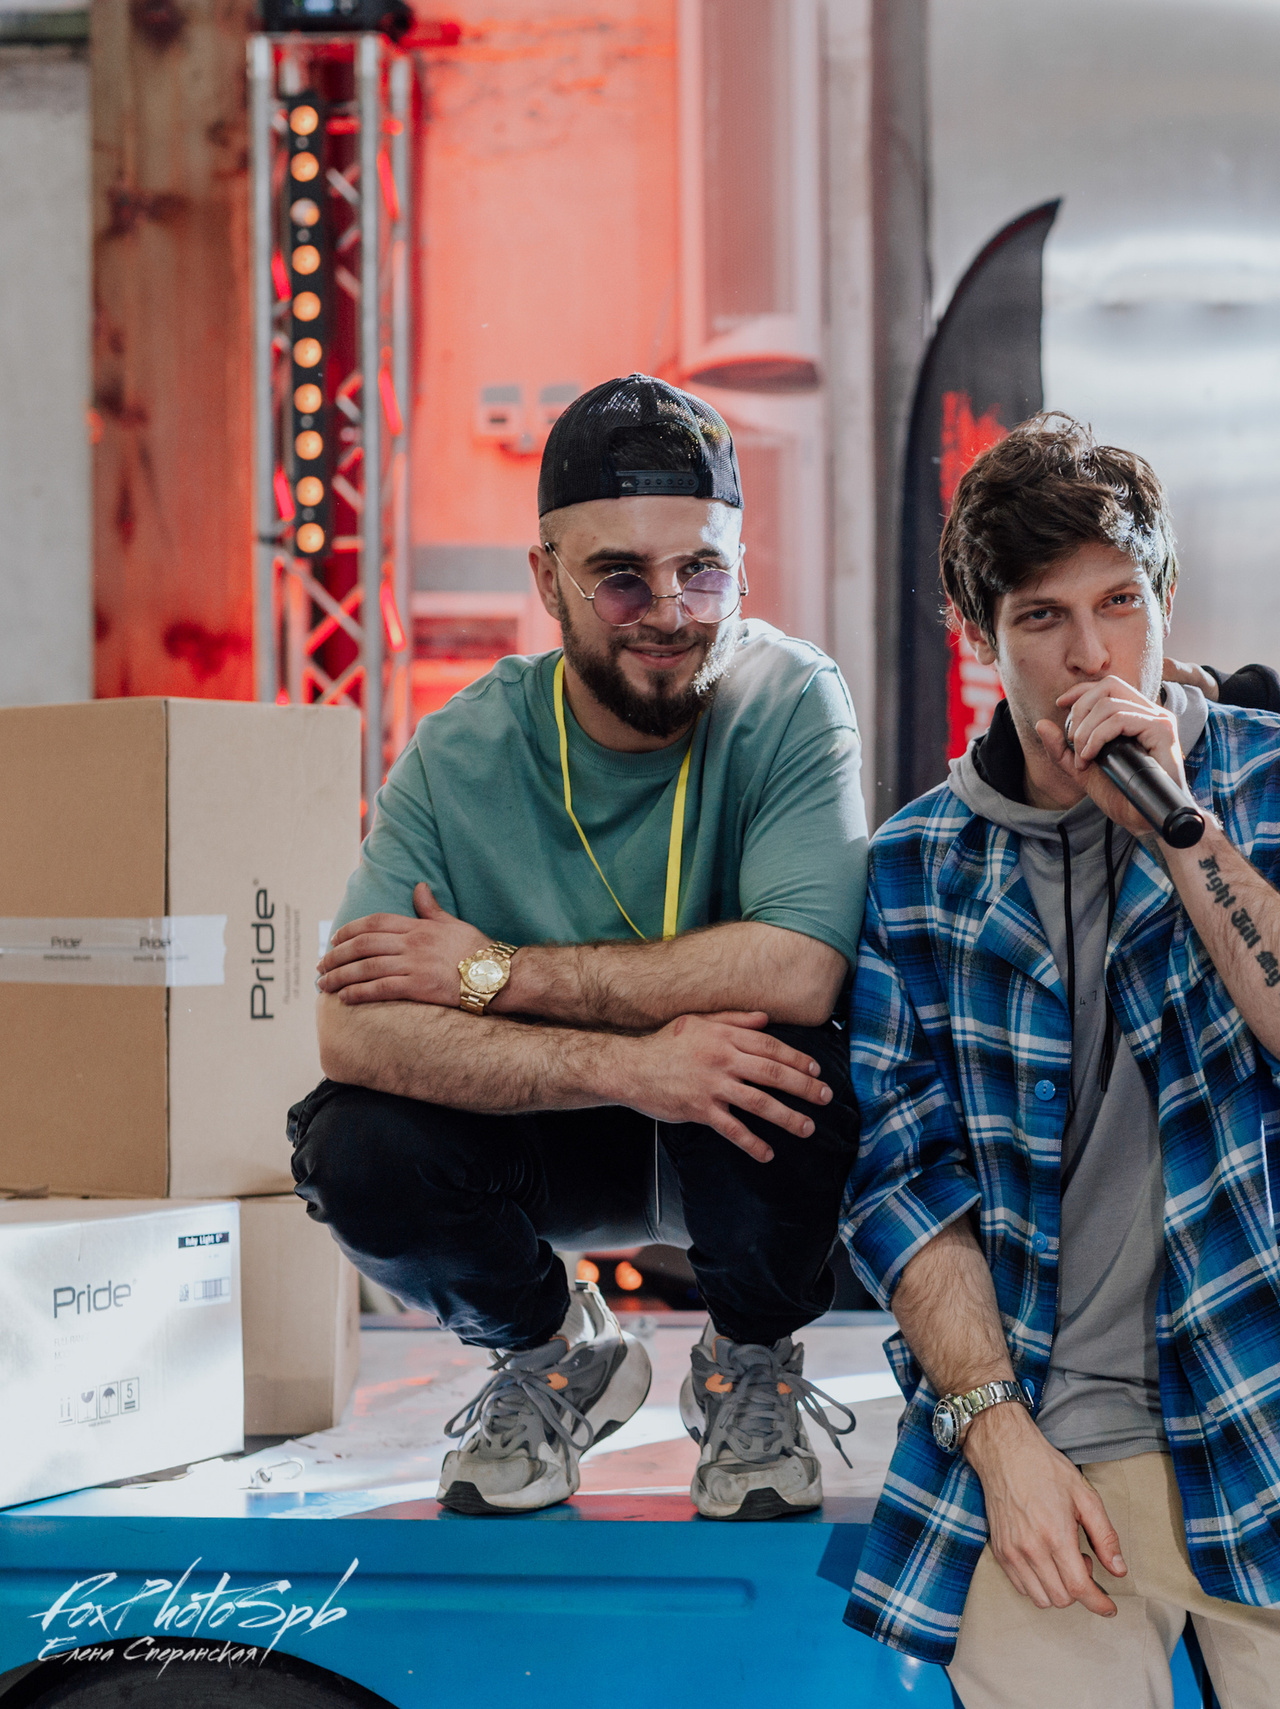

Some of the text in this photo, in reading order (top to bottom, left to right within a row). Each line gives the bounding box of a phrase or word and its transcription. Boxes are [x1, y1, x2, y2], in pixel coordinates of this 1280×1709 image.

[1198, 855, 1237, 909] Fight
[1231, 907, 1262, 949] Till
[250, 887, 275, 1020] Pride
[53, 1280, 132, 1319] Pride
[125, 1382, 134, 1400] 5
